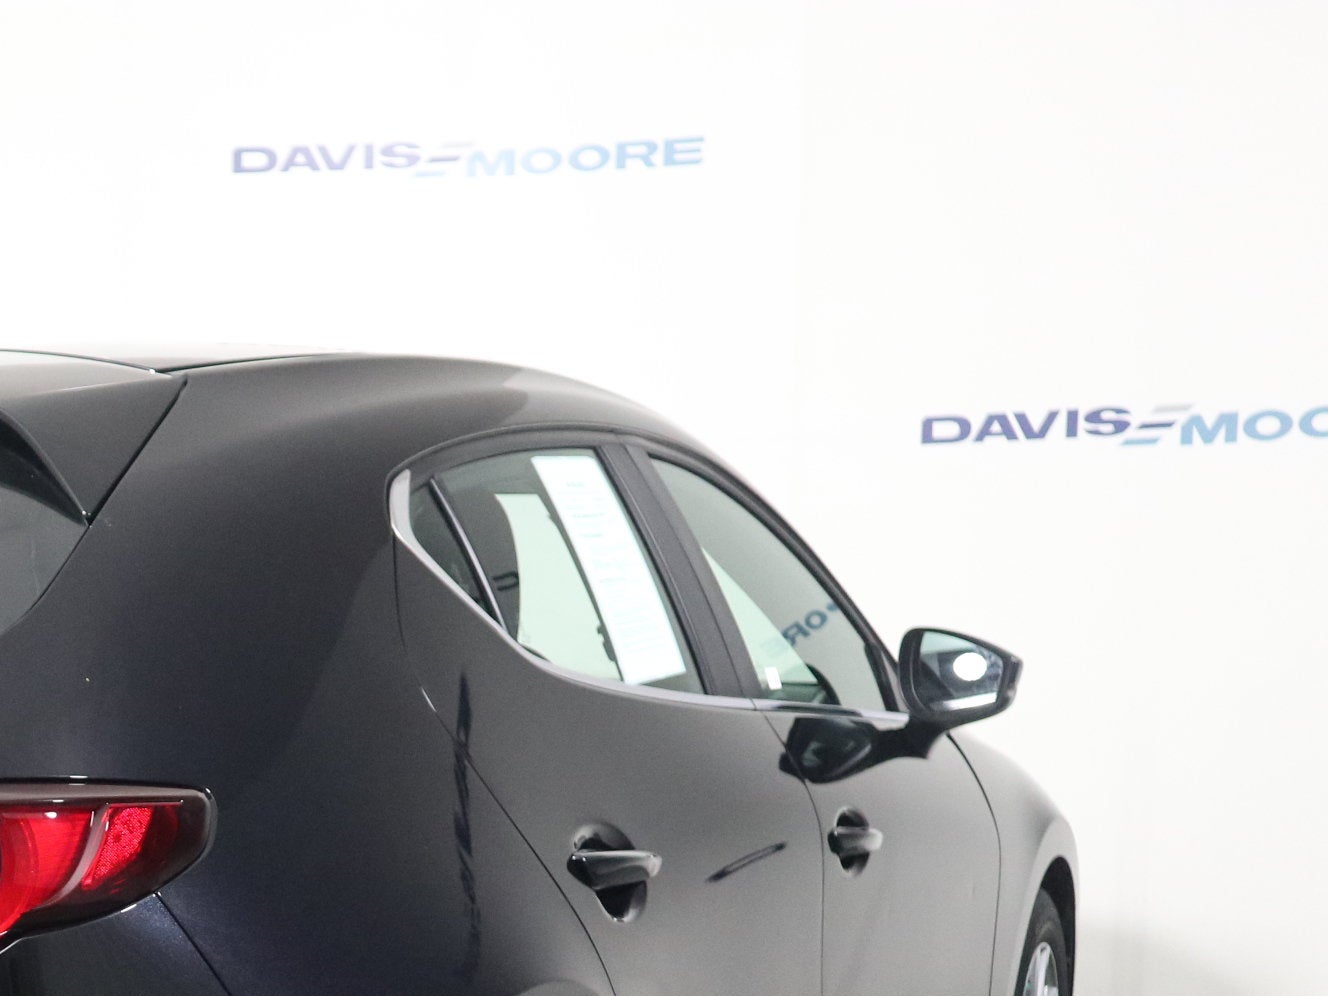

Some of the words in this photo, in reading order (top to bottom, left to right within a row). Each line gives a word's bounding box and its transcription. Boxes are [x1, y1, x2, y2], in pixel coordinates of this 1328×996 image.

[232, 141, 421, 174] DAVIS
[465, 136, 705, 177] MOORE
[920, 406, 1131, 445] DAVIS
